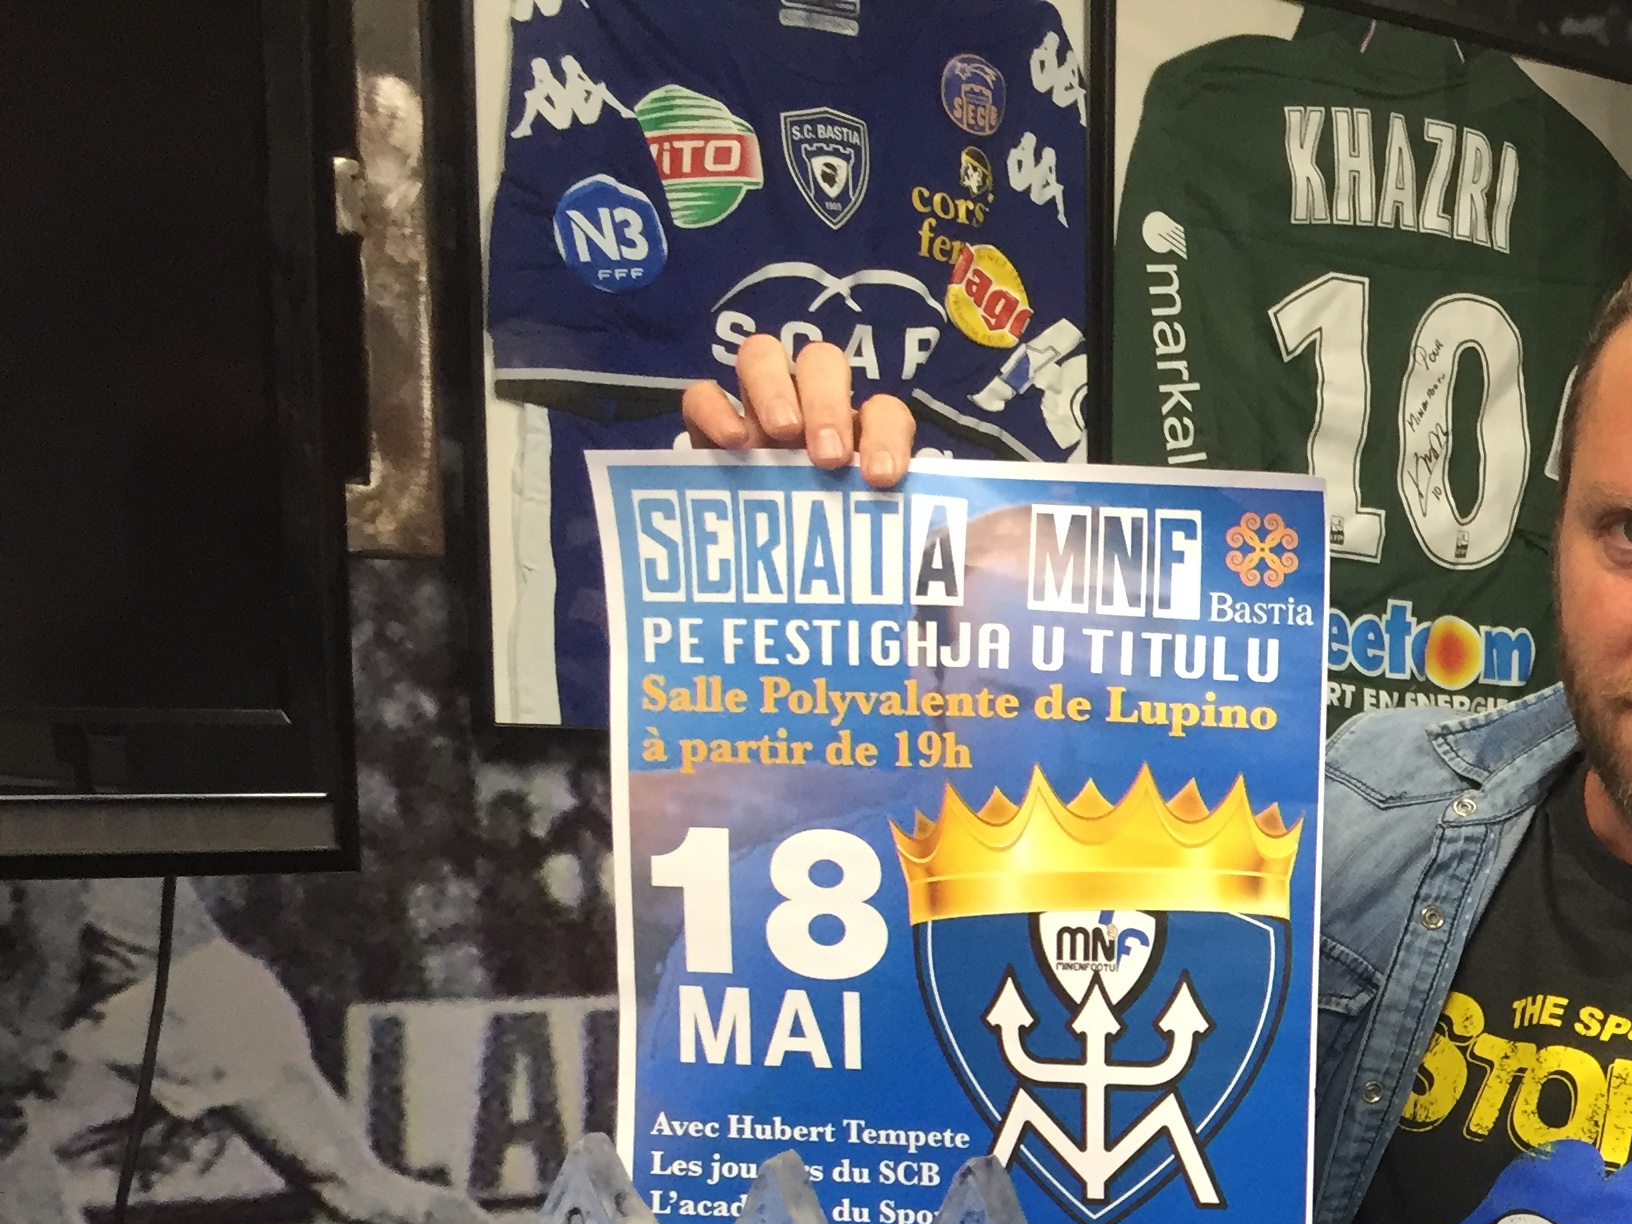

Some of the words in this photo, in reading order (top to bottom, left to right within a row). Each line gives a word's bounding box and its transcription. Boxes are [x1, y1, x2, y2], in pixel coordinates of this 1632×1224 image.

[818, 124, 861, 146] BASTIA
[1284, 106, 1519, 254] KHAZRI
[566, 207, 649, 262] N3
[598, 268, 644, 280] FFF
[1146, 262, 1207, 465] markal
[1268, 272, 1530, 571] 10
[631, 489, 967, 606] SERATA
[1027, 503, 1202, 620] MNF
[1209, 591, 1315, 627] Bastia
[643, 617, 703, 664] PE
[724, 618, 1010, 670] FESTIGHJA
[1032, 625, 1065, 672] U
[1083, 627, 1280, 683] TITULU
[643, 675, 747, 715] Salle
[760, 676, 1020, 728] Polyvalente
[1036, 683, 1092, 722] de
[1107, 687, 1278, 738] Lupino
[643, 729, 667, 764] à
[680, 730, 812, 774] partir
[825, 730, 879, 768] de
[895, 730, 973, 769] 19h
[650, 826, 889, 981] 18
[678, 985, 862, 1071] MAI
[1512, 995, 1574, 1030] THE
[651, 1111, 719, 1139] Avec
[727, 1114, 836, 1144] Hubert
[842, 1117, 970, 1150] Tempete
[650, 1150, 703, 1177] Les
[832, 1158, 871, 1184] du
[879, 1160, 941, 1187] SCB
[832, 1198, 871, 1223] du
